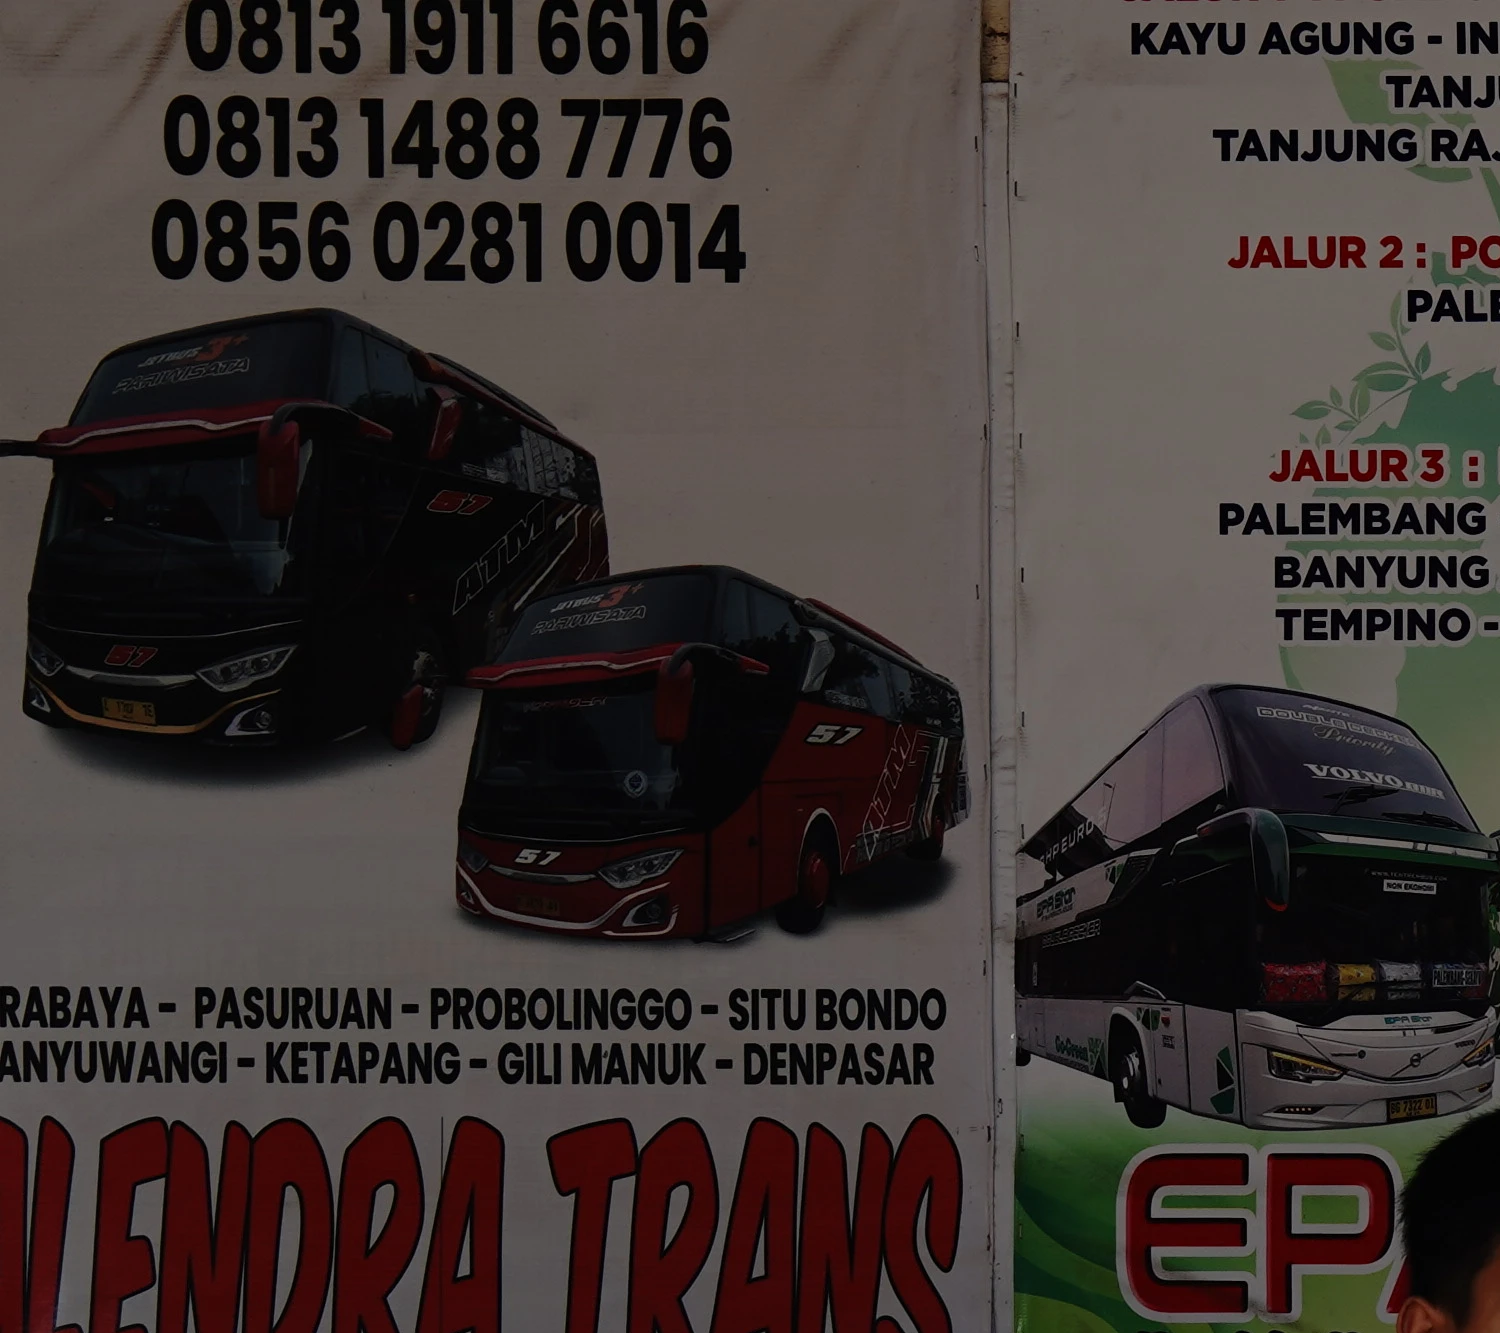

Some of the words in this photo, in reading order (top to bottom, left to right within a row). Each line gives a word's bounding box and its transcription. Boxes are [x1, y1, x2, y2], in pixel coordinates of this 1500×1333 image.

[1131, 22, 1245, 55] KAYU
[1258, 21, 1414, 55] AGUNG
[164, 95, 338, 178] 0813
[360, 97, 540, 180] 1488
[561, 97, 732, 179] 7776
[152, 199, 351, 282] 0856
[373, 201, 542, 284] 0281
[566, 201, 746, 283] 0014
[1228, 236, 1366, 268] JALUR
[1380, 236, 1403, 268] 2
[806, 723, 861, 744] 57
[1304, 764, 1400, 789] VOLVO
[195, 987, 391, 1029] PASURUAN
[431, 988, 692, 1031] PROBOLINGGO
[729, 988, 806, 1030] SITU
[816, 988, 946, 1031] BONDO
[266, 1042, 460, 1084] KETAPANG
[498, 1042, 561, 1084] GILI
[572, 1043, 706, 1085] MANUK
[744, 1043, 934, 1085] DENPASAR
[1129, 1153, 1408, 1314] EP
